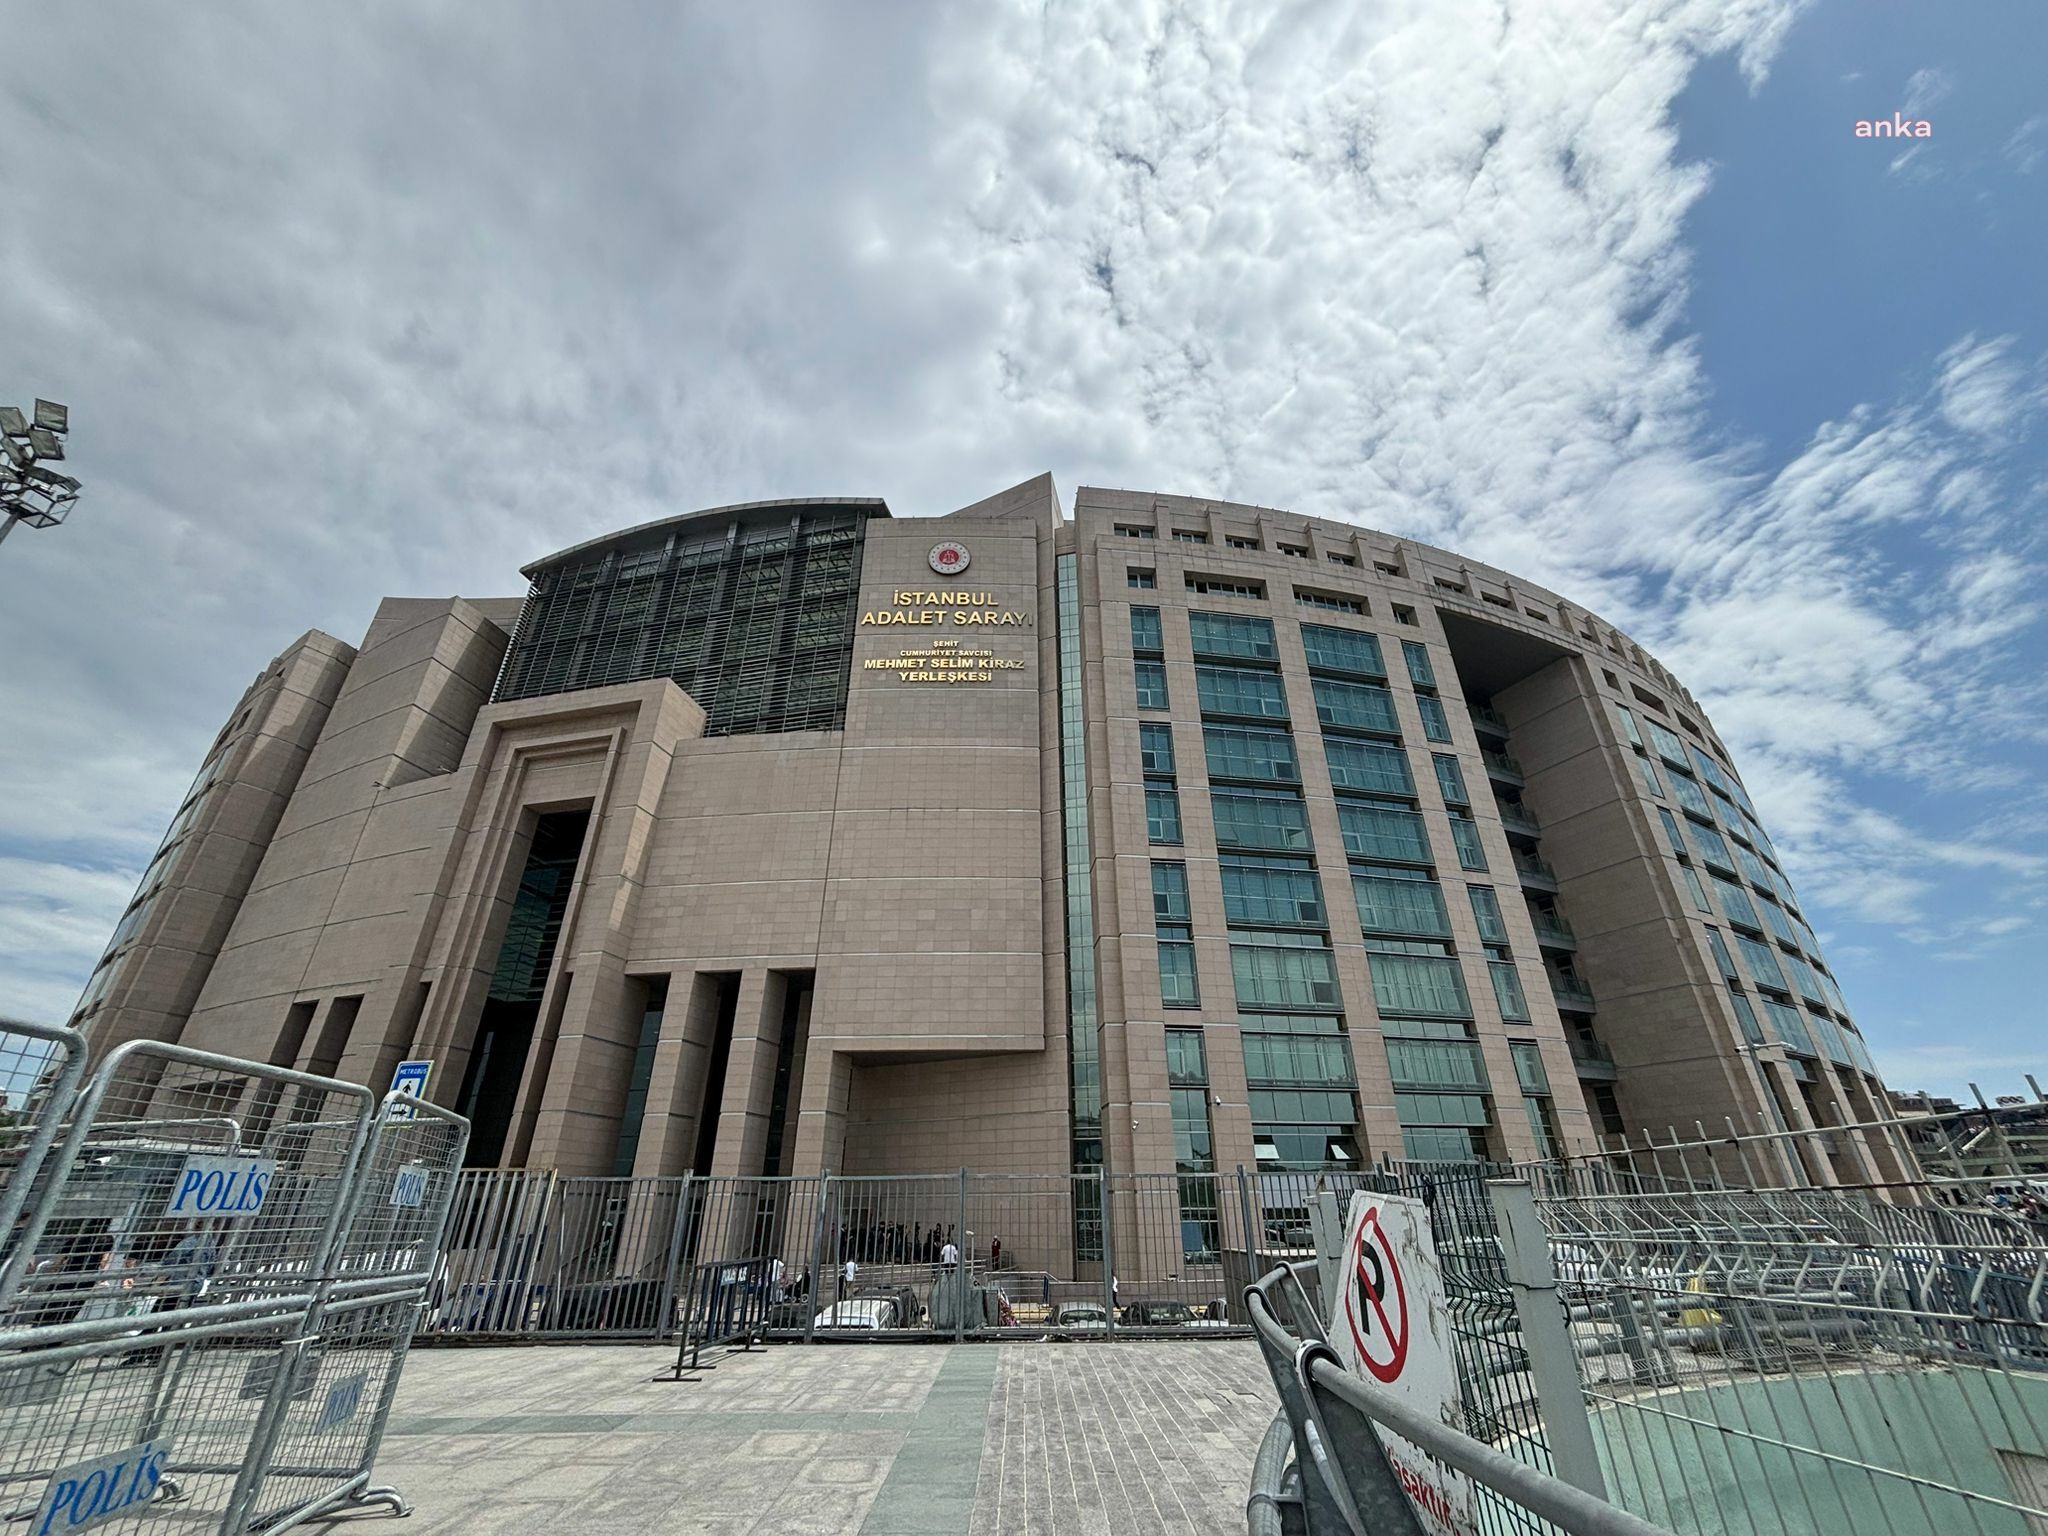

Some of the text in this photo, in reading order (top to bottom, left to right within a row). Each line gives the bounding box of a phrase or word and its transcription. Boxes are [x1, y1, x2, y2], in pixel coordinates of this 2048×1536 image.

[893, 590, 999, 606] İSTANBUL
[861, 609, 1033, 626] ADALET SARAYI
[933, 640, 959, 648] ŞEHİT
[864, 657, 1025, 669] MEHMET SELİM KİRAZ
[899, 670, 992, 684] YERLEŞKESİ
[172, 1164, 269, 1211] POLİS
[38, 1443, 168, 1536] POLİS
